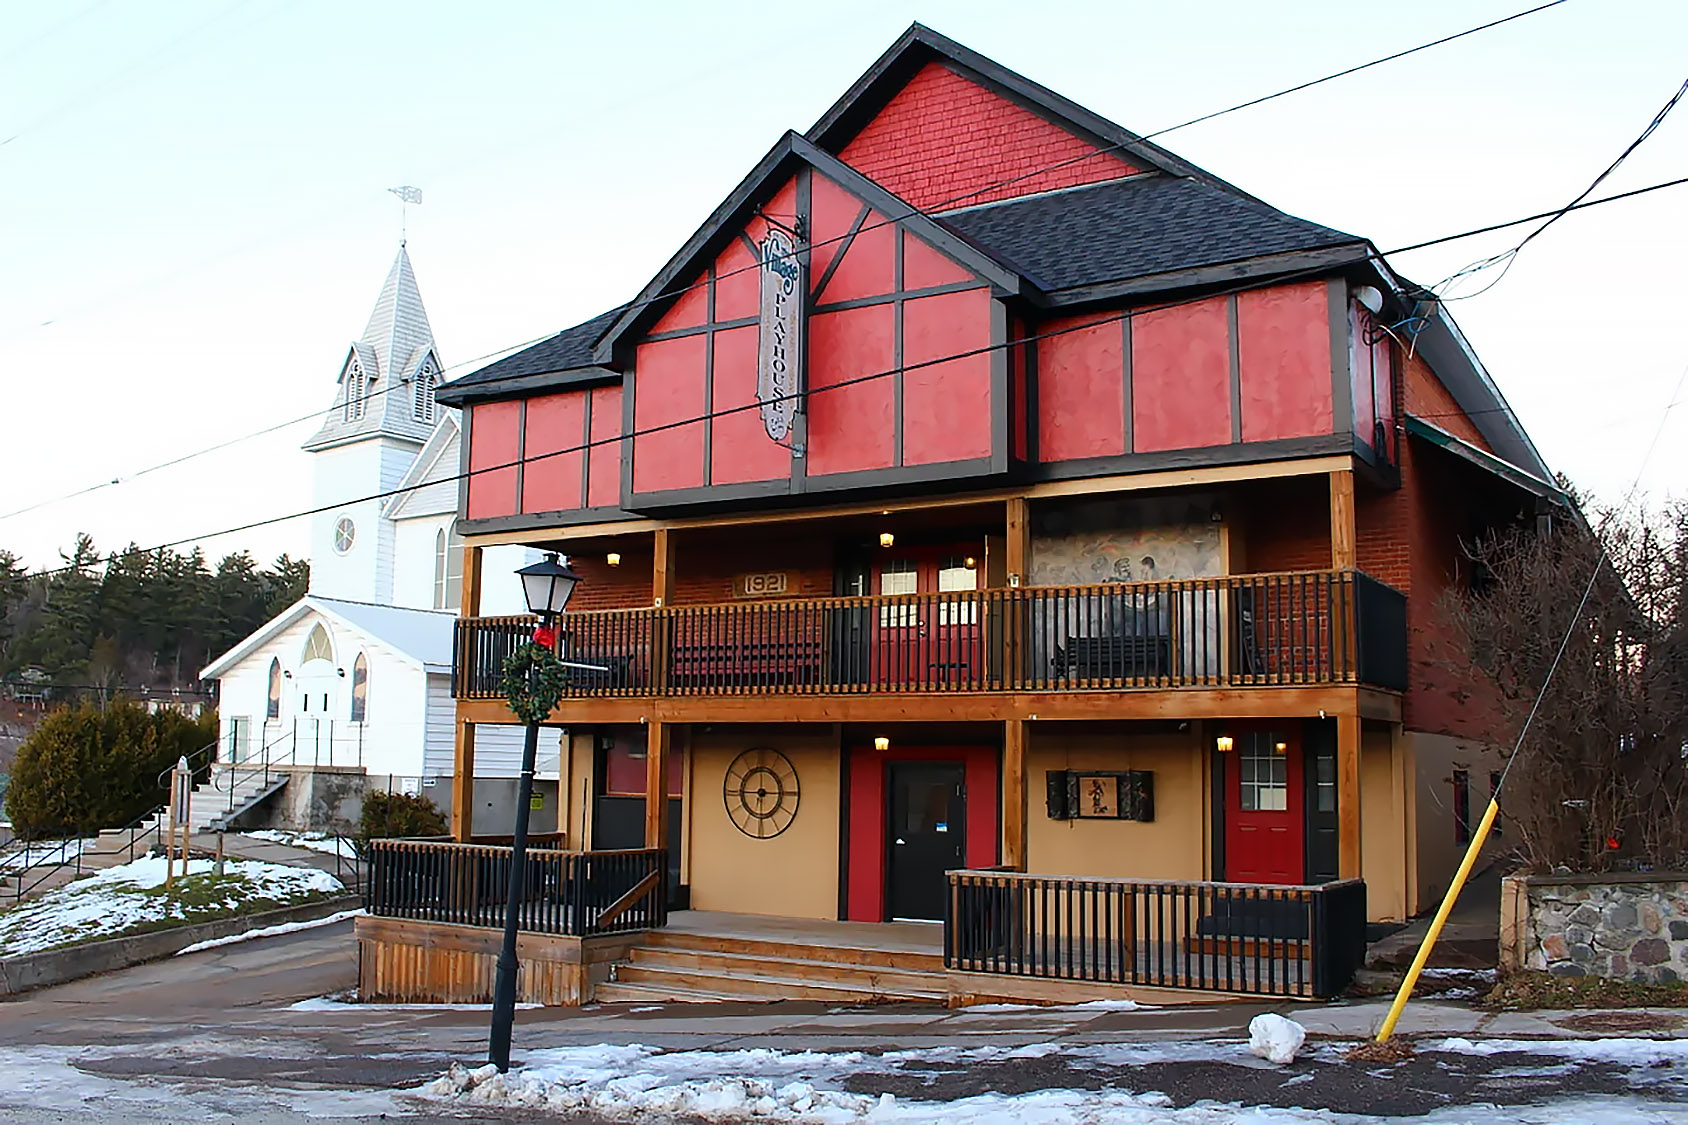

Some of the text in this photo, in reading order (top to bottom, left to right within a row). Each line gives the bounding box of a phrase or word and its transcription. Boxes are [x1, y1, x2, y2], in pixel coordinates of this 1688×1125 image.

[764, 238, 798, 295] Village
[772, 293, 786, 413] PLAYHOUSE
[746, 574, 785, 593] 1921
